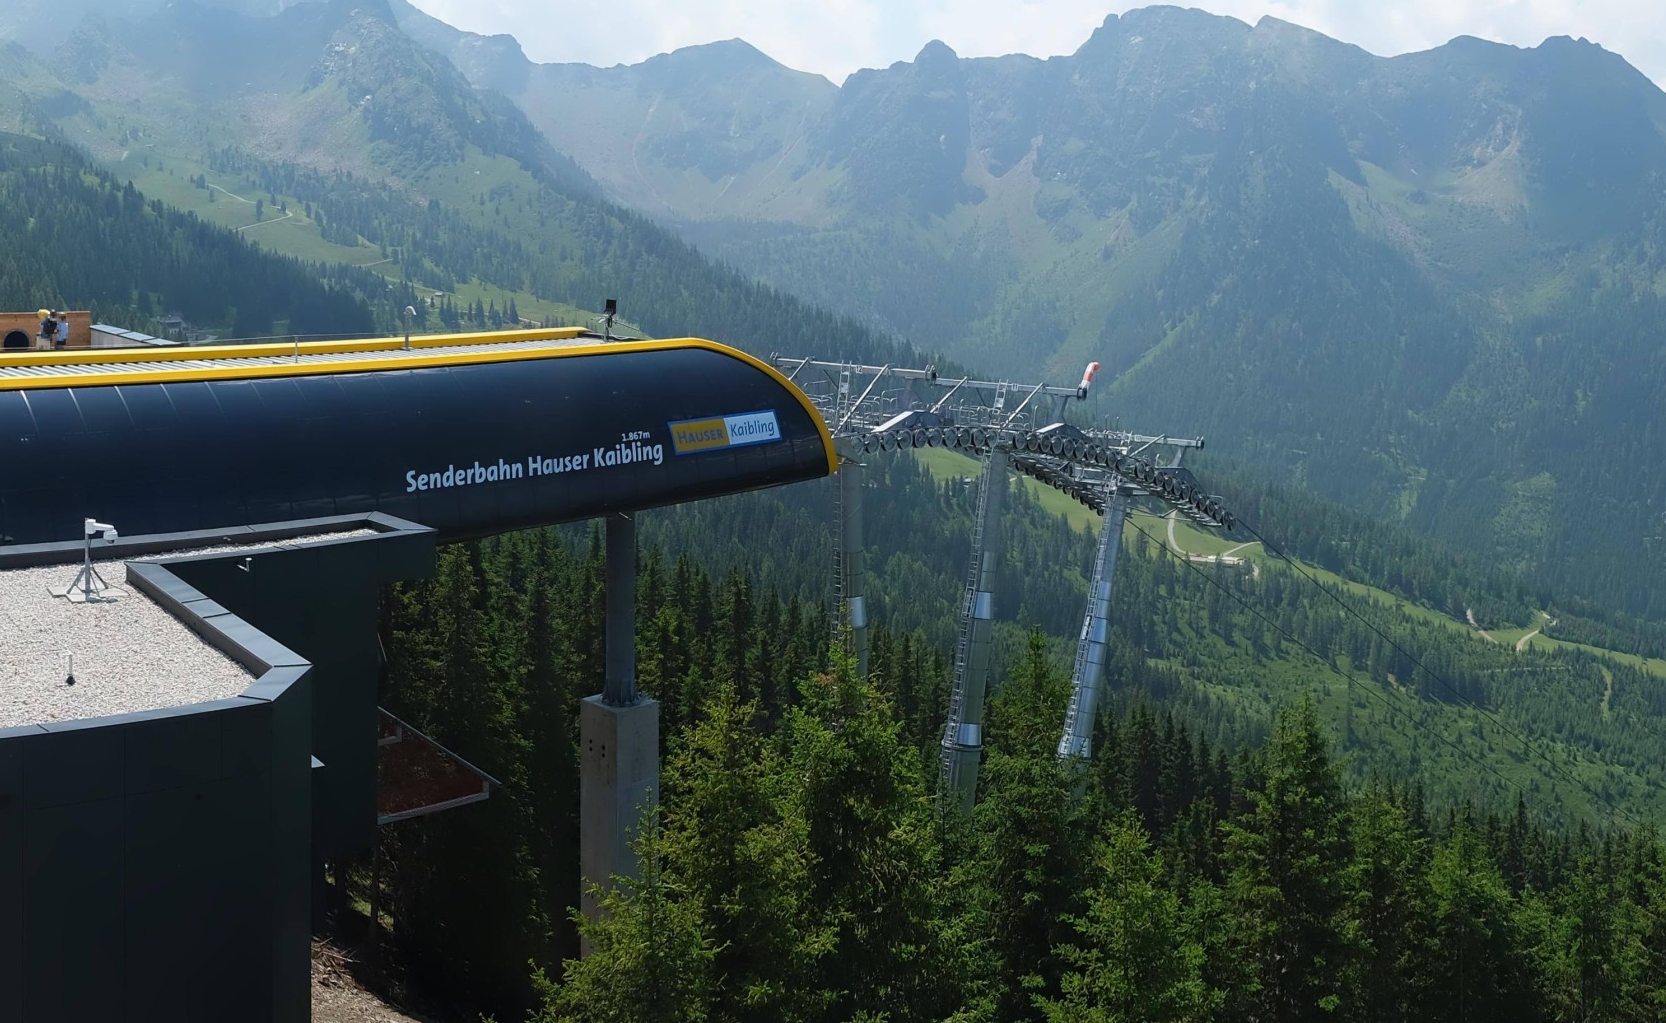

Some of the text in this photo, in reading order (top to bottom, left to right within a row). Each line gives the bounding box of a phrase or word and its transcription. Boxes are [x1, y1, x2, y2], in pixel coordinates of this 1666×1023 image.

[621, 430, 651, 442] 1.867m
[677, 419, 776, 445] HAUSER Kaibling
[405, 441, 664, 493] Senderbahn Hauser Kaibling
